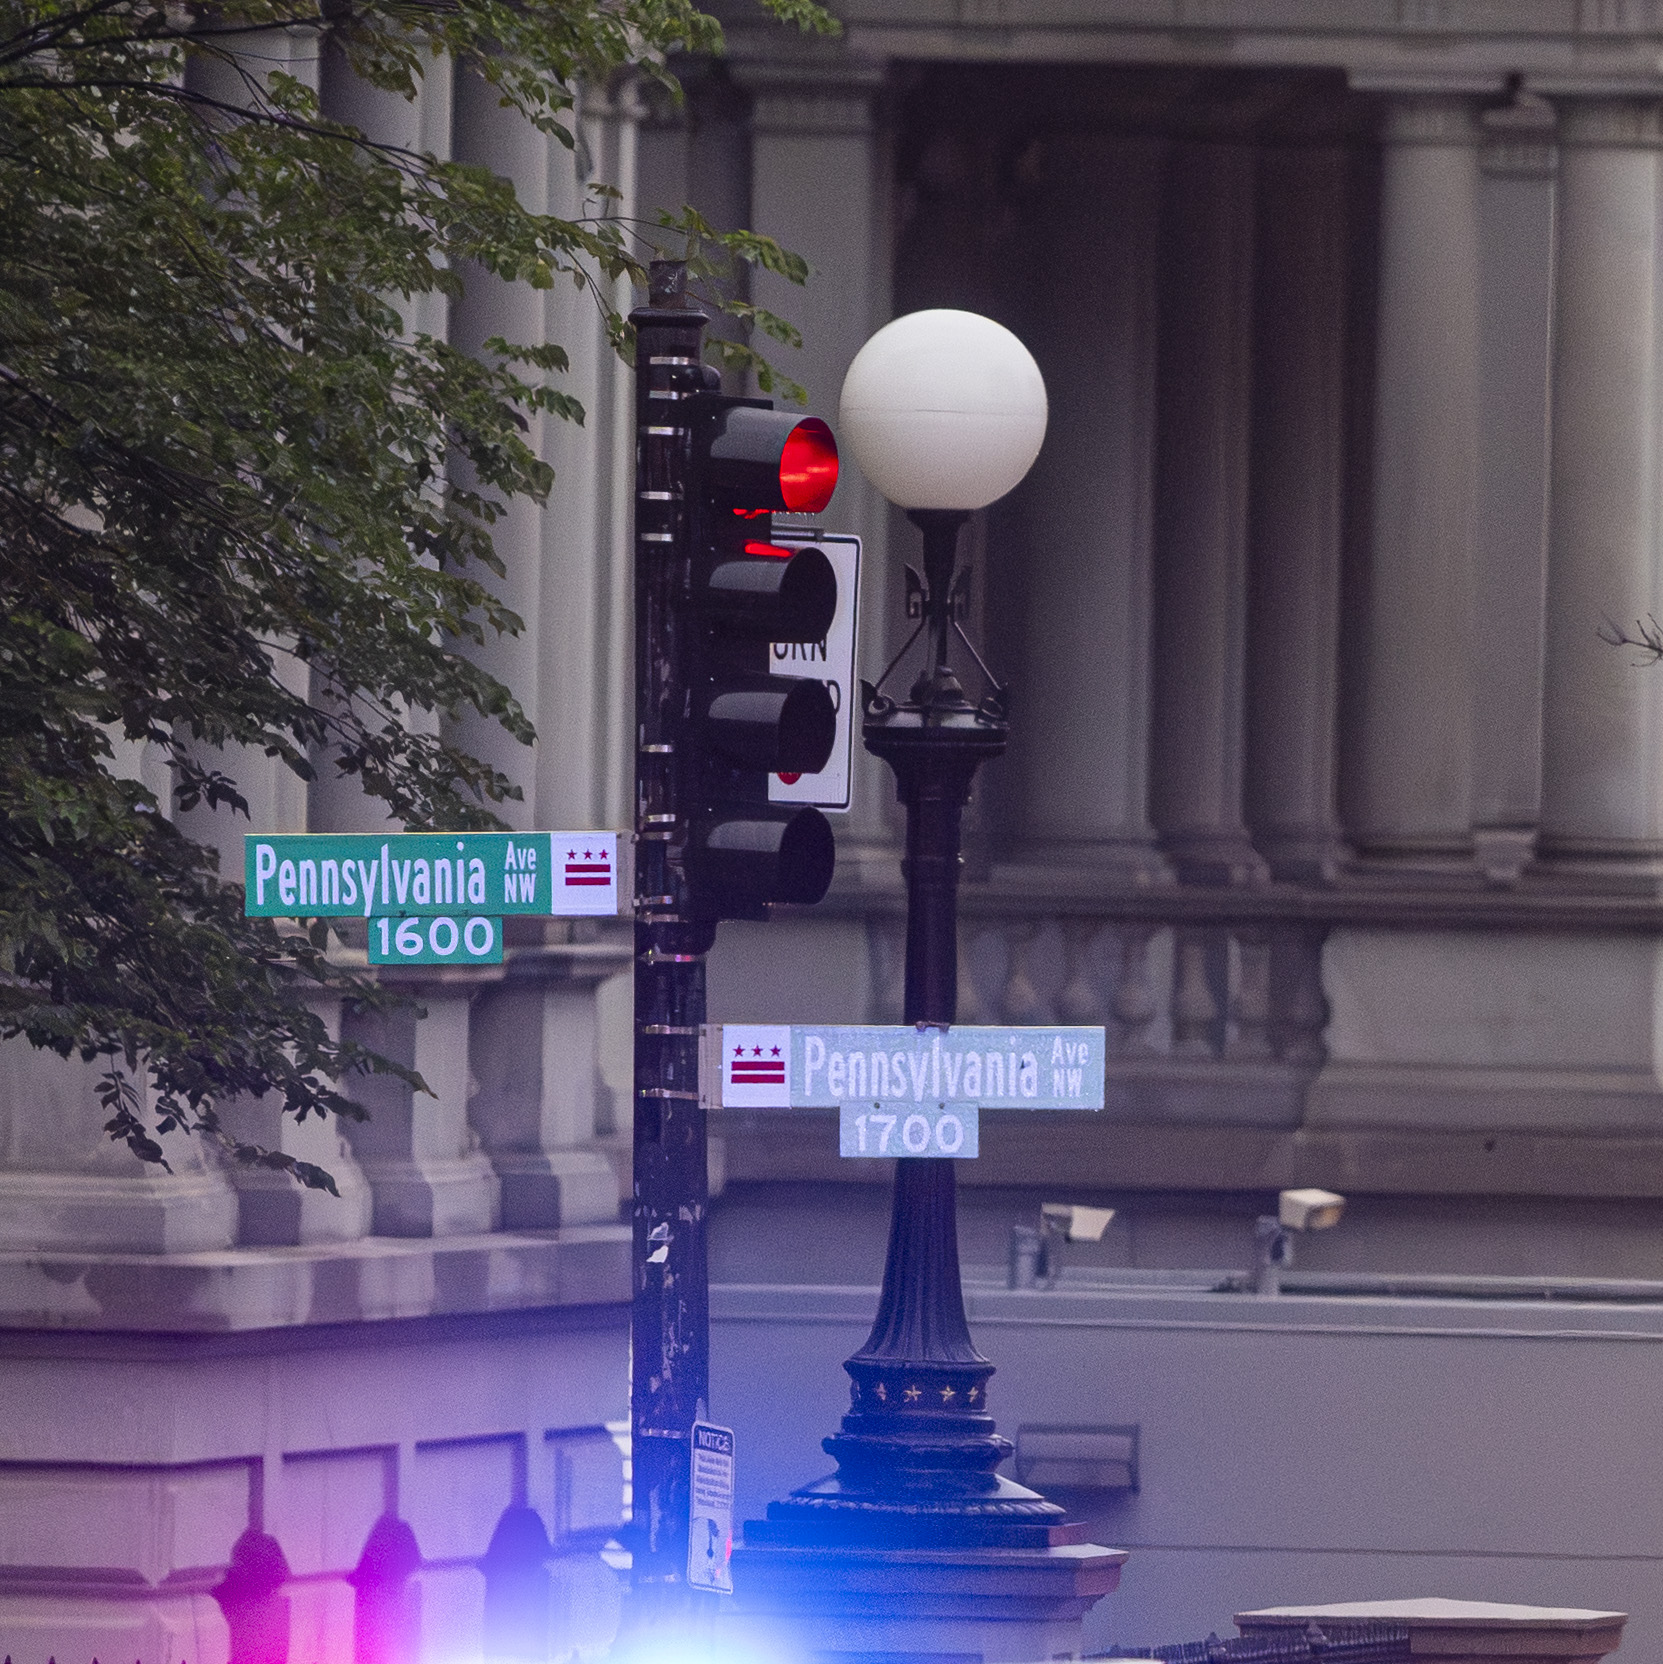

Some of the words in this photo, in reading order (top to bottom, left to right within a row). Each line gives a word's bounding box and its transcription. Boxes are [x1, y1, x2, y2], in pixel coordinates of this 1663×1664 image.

[504, 841, 537, 871] Ave
[255, 842, 486, 917] Pennsylvania
[504, 873, 537, 903] NW
[377, 917, 494, 956] 1600
[1051, 1036, 1089, 1065] Ave
[803, 1035, 1038, 1102] Pennsylvania
[1053, 1067, 1083, 1098] NW
[855, 1114, 964, 1154] 1700
